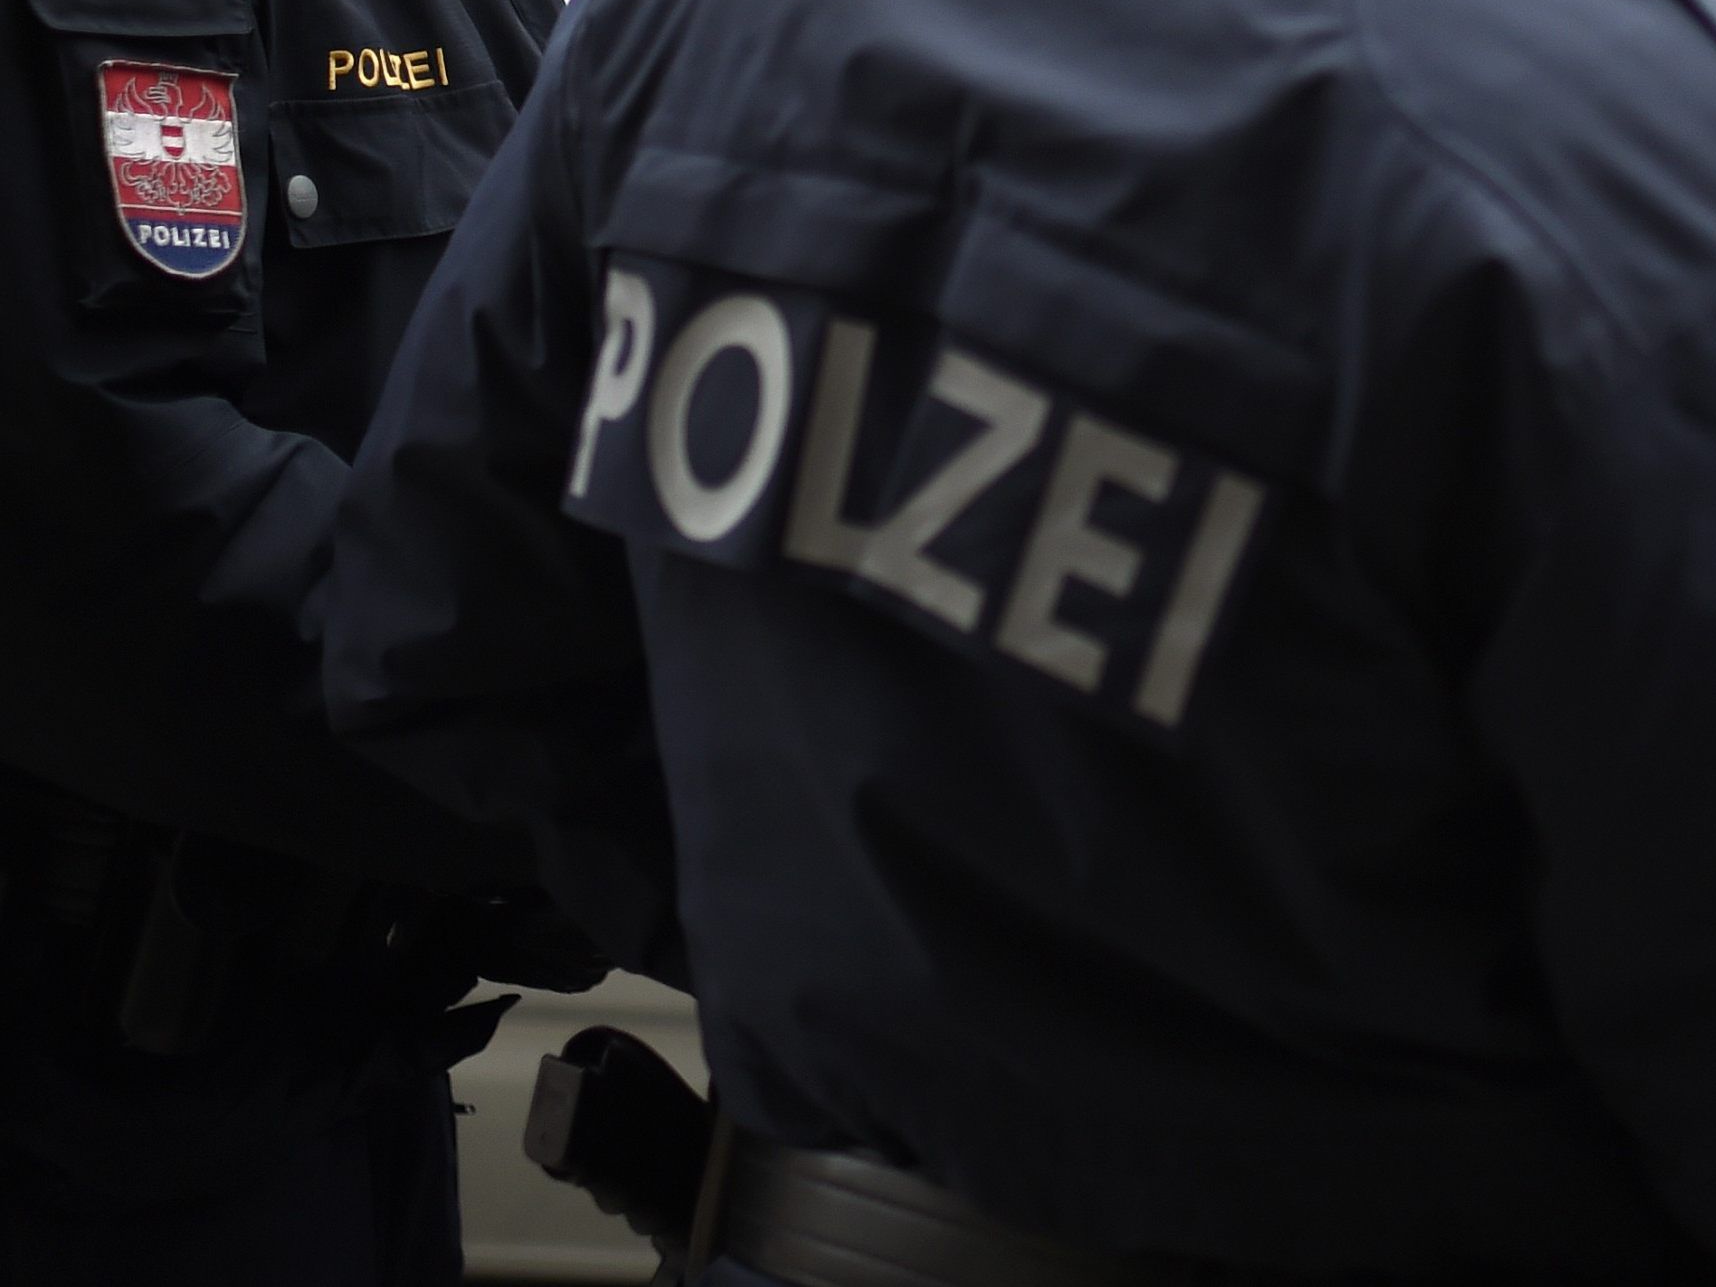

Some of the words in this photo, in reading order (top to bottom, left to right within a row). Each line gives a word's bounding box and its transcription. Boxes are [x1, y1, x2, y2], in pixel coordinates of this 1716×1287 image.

[328, 47, 449, 91] POLZEI
[138, 224, 230, 249] POLIZEI
[567, 268, 1268, 728] POLZEI
